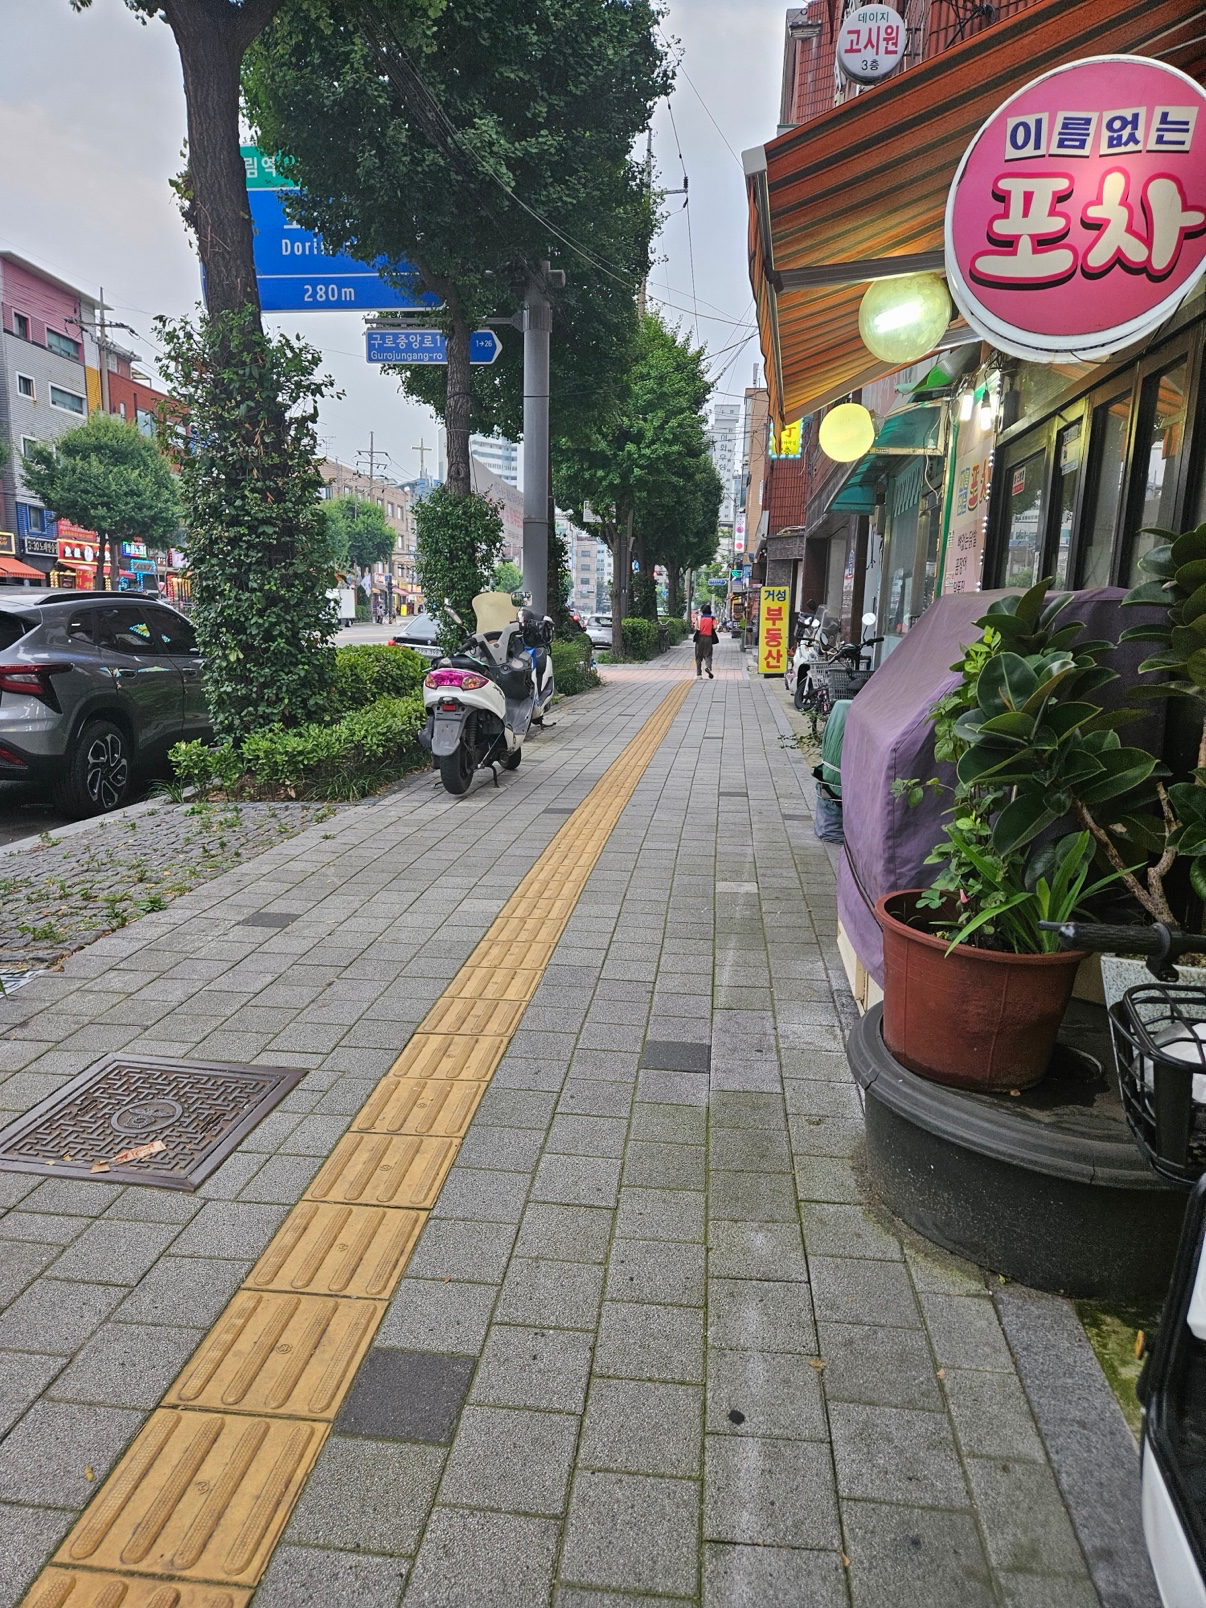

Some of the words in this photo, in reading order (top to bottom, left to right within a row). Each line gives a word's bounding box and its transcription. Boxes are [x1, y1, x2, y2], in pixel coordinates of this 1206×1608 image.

[858, 11, 889, 23] 데이지
[844, 25, 899, 56] 고시원
[861, 59, 880, 71] 3층
[1009, 111, 1191, 151] 이름없는
[971, 167, 1206, 284] 포차
[303, 284, 355, 302] 280m
[370, 350, 443, 361] Gurojungang-ro
[764, 589, 786, 602] 거성
[764, 606, 783, 669] 부동산
